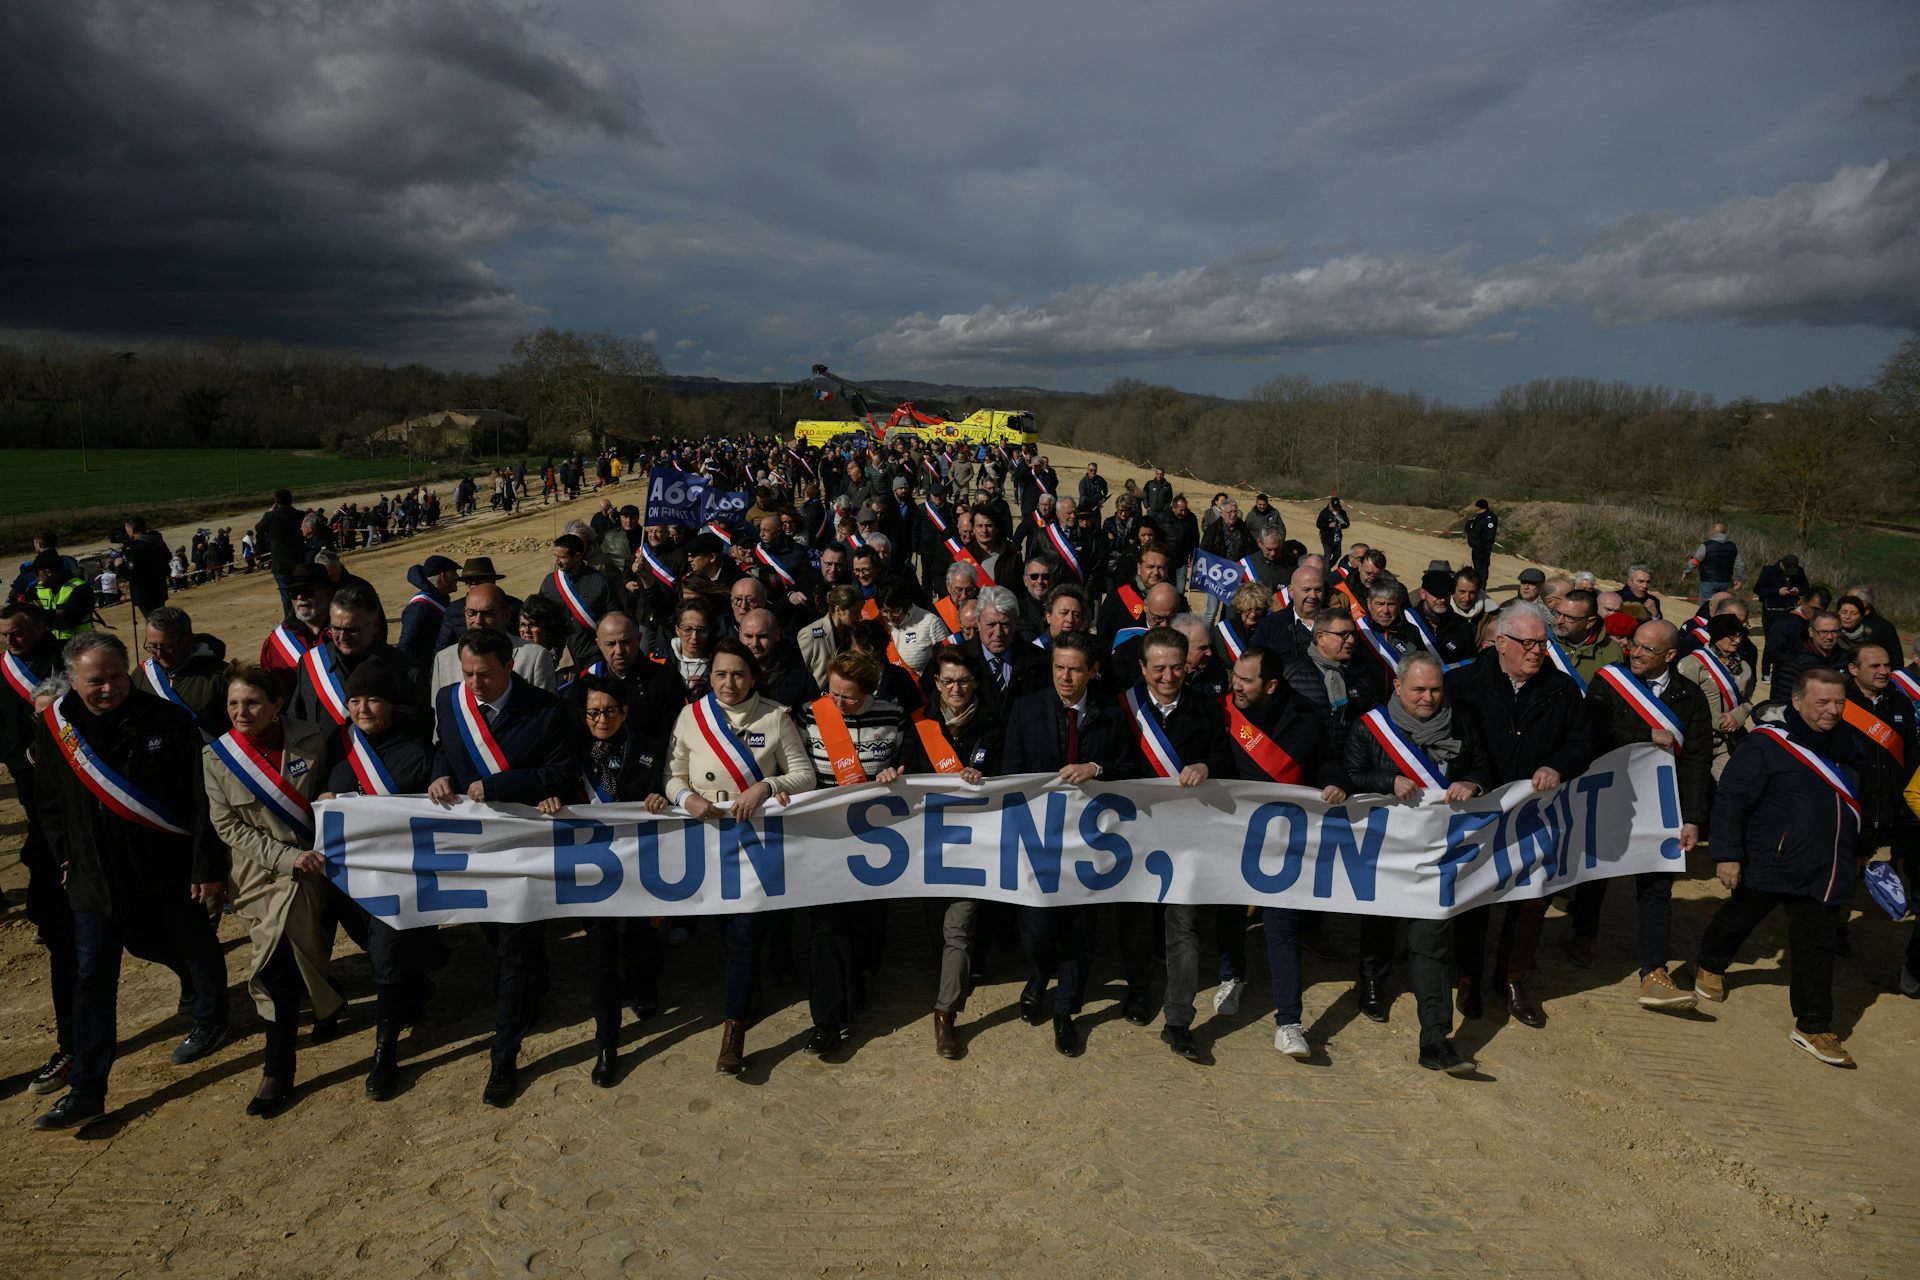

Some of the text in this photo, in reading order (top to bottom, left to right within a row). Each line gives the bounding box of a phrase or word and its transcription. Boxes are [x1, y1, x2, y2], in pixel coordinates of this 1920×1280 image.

[649, 477, 704, 505] A69
[705, 493, 745, 511] A69
[648, 506, 659, 519] ON
[1193, 557, 1238, 586] A69
[290, 760, 306, 773] A69
[833, 754, 855, 771] TARN
[935, 754, 956, 771] TARN
[323, 811, 488, 917] LE
[553, 816, 786, 905] BUN
[846, 791, 1174, 904] SENS,
[1240, 801, 1390, 902] ON
[1438, 771, 1614, 907] FINIT
